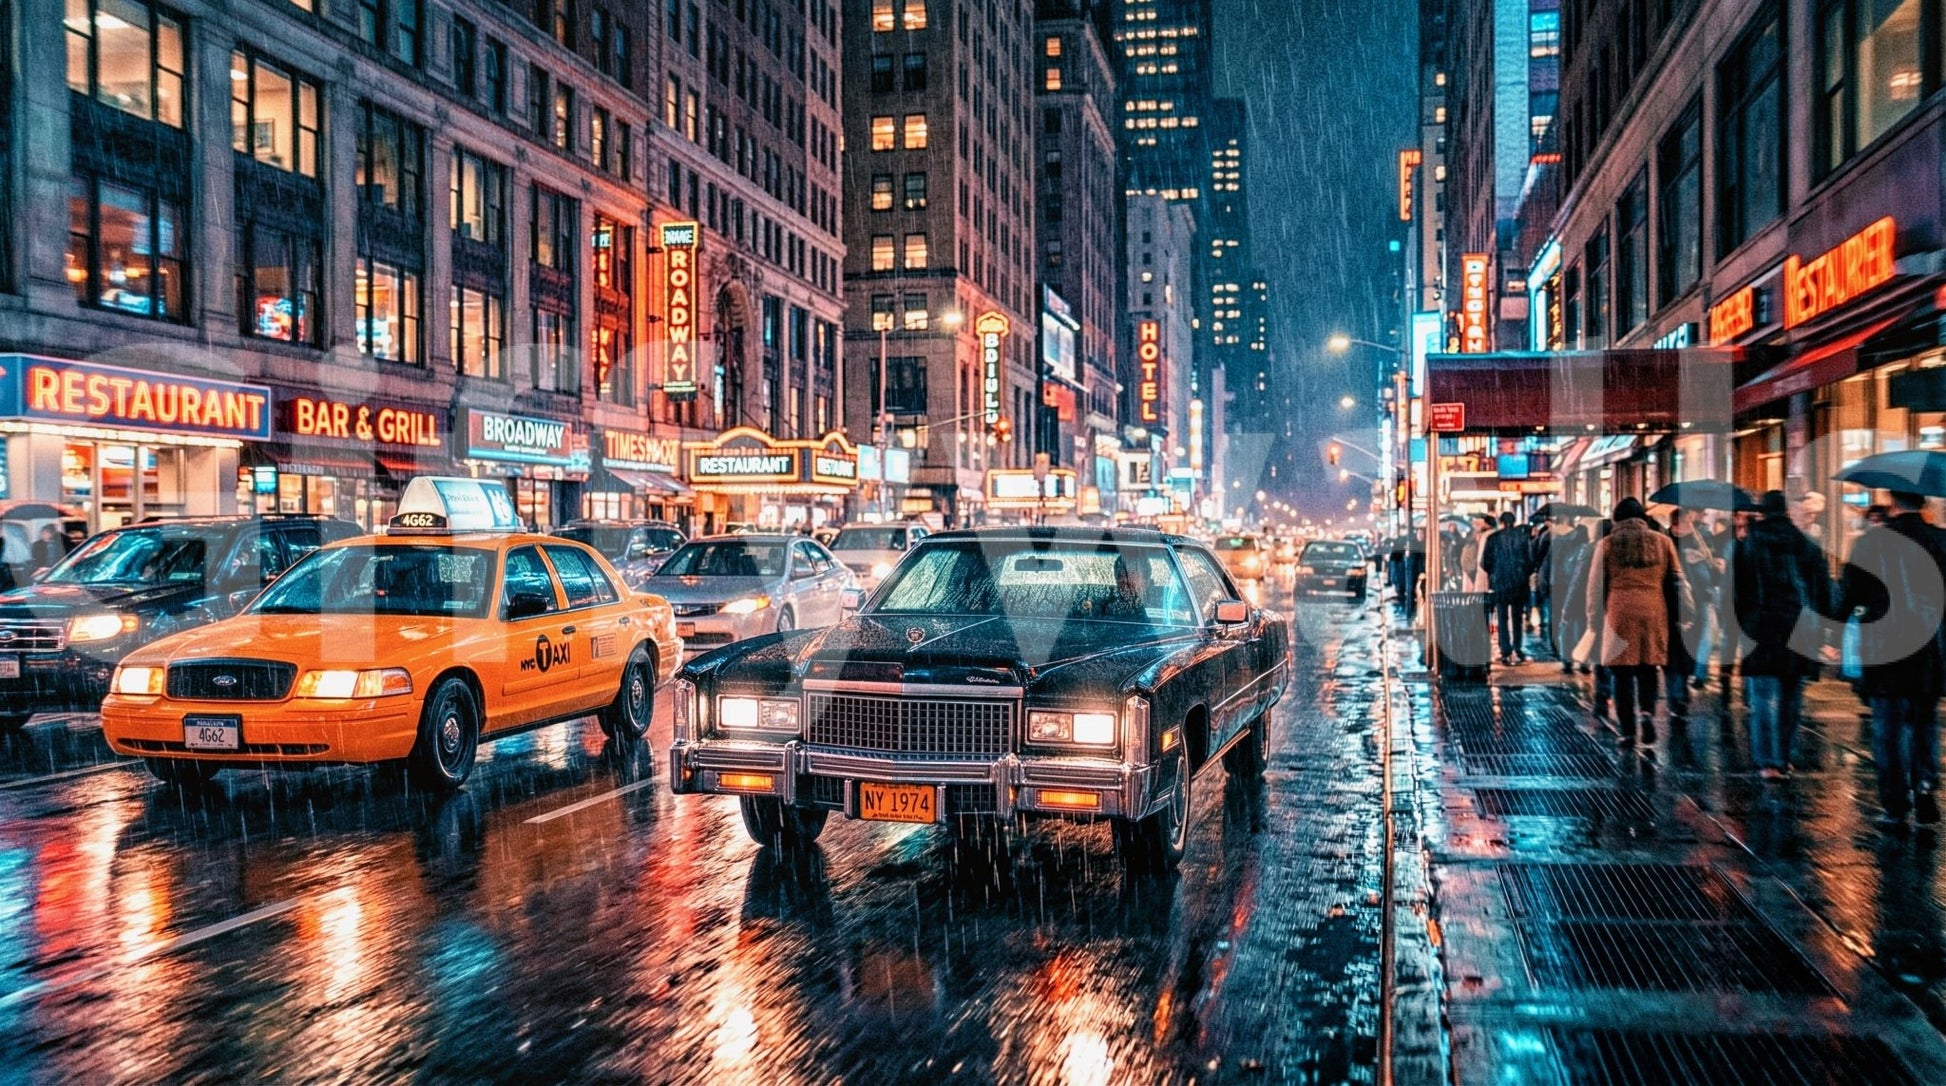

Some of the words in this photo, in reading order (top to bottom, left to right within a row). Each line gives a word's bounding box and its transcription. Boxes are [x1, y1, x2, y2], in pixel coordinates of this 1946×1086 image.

[1140, 322, 1158, 420] HOTEL
[30, 366, 266, 431] RESTAURANT
[297, 397, 349, 438] BAR
[355, 405, 374, 441] &
[378, 407, 441, 446] GRILL
[483, 415, 564, 449] BROADWAY
[700, 456, 789, 474] RESTAURANT
[402, 514, 434, 527] 4G62
[520, 658, 536, 672] NYC
[538, 638, 570, 670] TAXI
[199, 727, 225, 743] 4G62
[865, 790, 884, 811] NY
[891, 792, 929, 813] 1974
